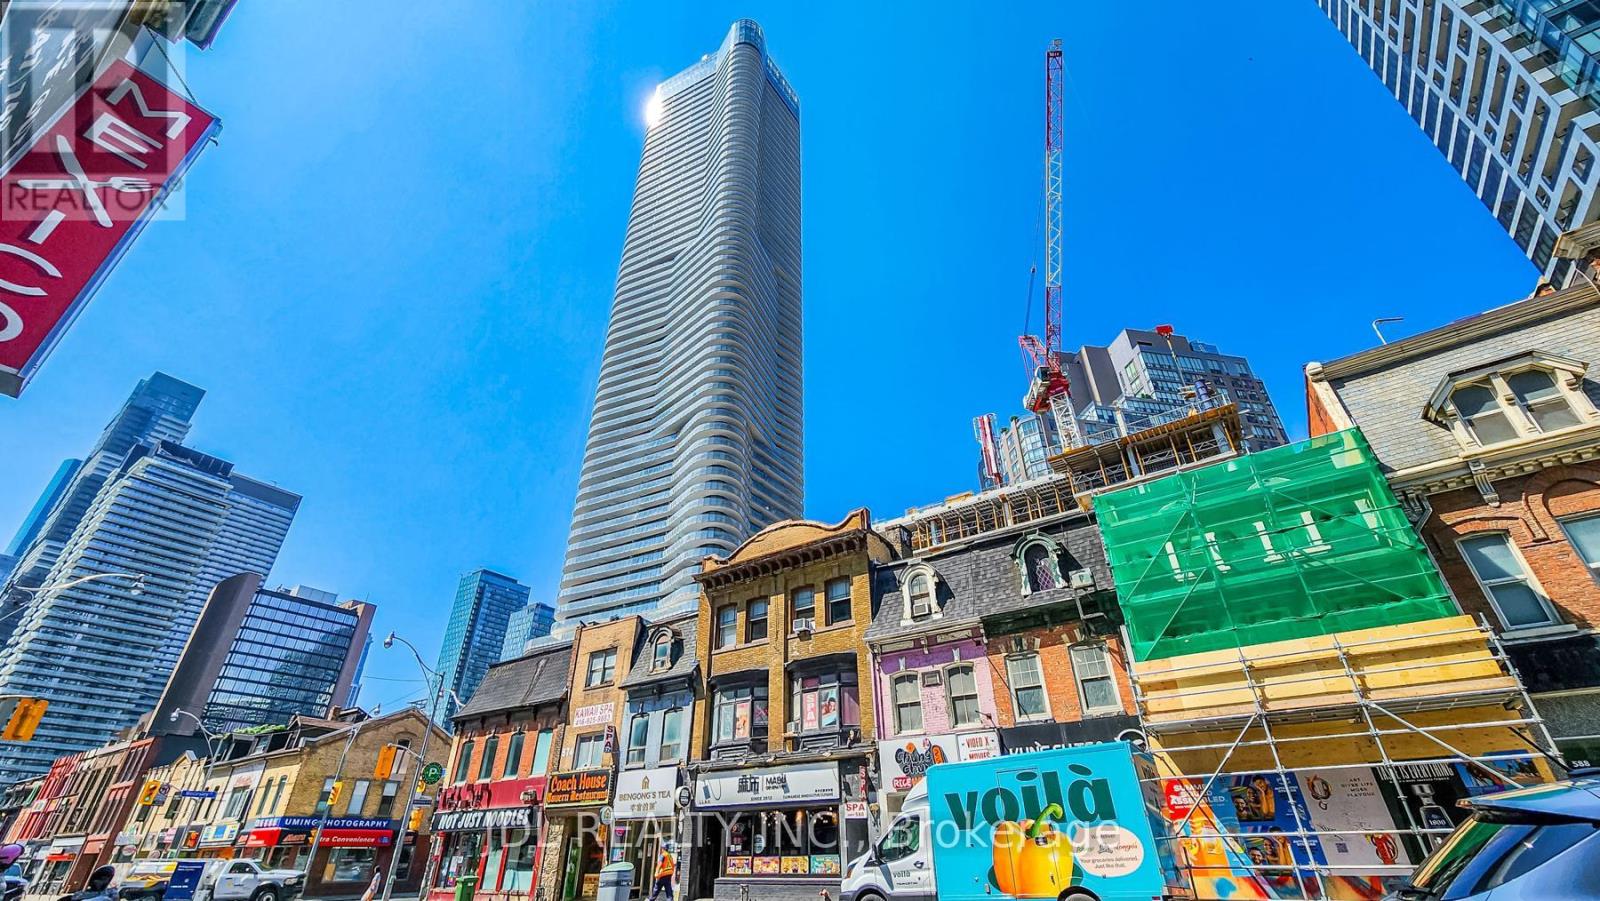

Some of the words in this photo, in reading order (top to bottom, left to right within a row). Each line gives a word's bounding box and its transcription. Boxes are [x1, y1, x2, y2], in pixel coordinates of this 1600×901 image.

[604, 725, 614, 748] SPA
[551, 774, 577, 792] Coach
[579, 772, 607, 789] House
[658, 790, 671, 799] TEA
[945, 763, 1118, 831] voilà
[846, 803, 864, 811] SPA
[438, 813, 460, 830] NOT
[459, 811, 483, 828] JUST
[482, 808, 532, 827] NOODLES
